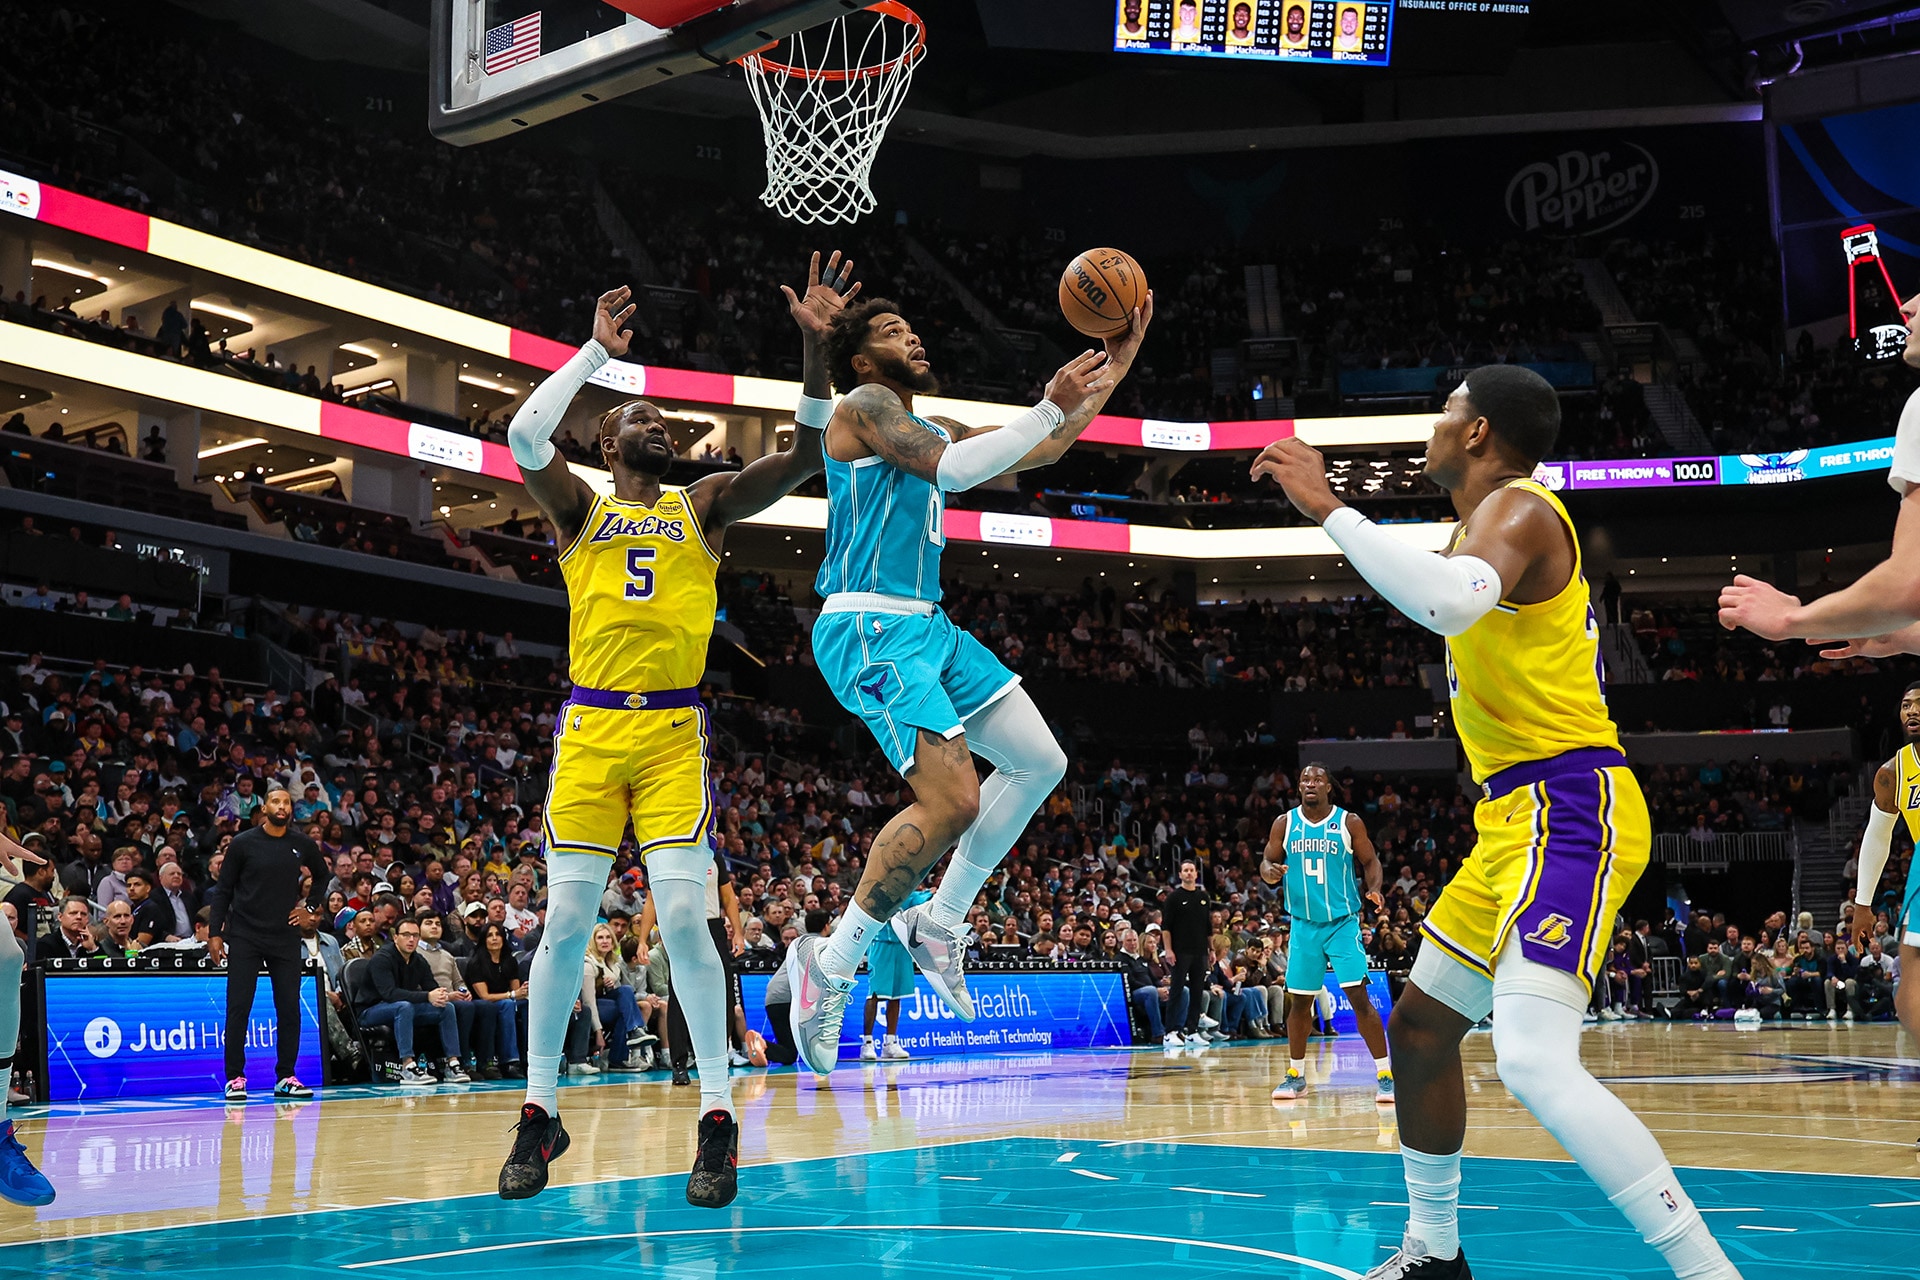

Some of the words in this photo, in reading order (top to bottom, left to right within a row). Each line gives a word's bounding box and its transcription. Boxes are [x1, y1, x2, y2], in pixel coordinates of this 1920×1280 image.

[1399, 0, 1445, 9] INSURANCE
[1448, 2, 1477, 11] OFFICE
[1480, 3, 1490, 12] OF
[1492, 4, 1530, 14] AMERICA
[1181, 43, 1212, 52] LaRavia
[1235, 45, 1276, 55] Hachimura
[1288, 49, 1312, 58] Smart
[1342, 52, 1367, 61] Doncic
[366, 96, 393, 112] 211
[696, 145, 721, 160] 212
[1557, 150, 1611, 192] Dr
[1507, 162, 1646, 231] Pepper
[1680, 205, 1705, 218] 215
[420, 441, 463, 457] POWER
[1820, 454, 1851, 467] FREE
[1576, 469, 1606, 480] FREE
[1608, 468, 1654, 479] THROW
[1656, 467, 1670, 478] %
[1674, 463, 1713, 479] 100.0
[1749, 469, 1802, 484] HORNETS
[589, 512, 686, 544] LAKERS
[624, 548, 656, 601] 5
[1291, 839, 1338, 855] HORNETS
[1305, 859, 1324, 884] 4
[53, 958, 62, 968] G
[78, 958, 87, 967] G
[103, 958, 112, 967] G
[127, 958, 136, 967] G
[151, 958, 160, 967] G
[175, 958, 182, 967] G
[198, 959, 205, 967] G
[220, 959, 228, 967] G
[306, 959, 313, 967] G
[130, 1020, 195, 1052] Judi
[919, 1032, 930, 1047] of
[932, 1030, 965, 1047] Health
[967, 1029, 1000, 1045] Benefit
[1001, 1028, 1051, 1044] Technology
